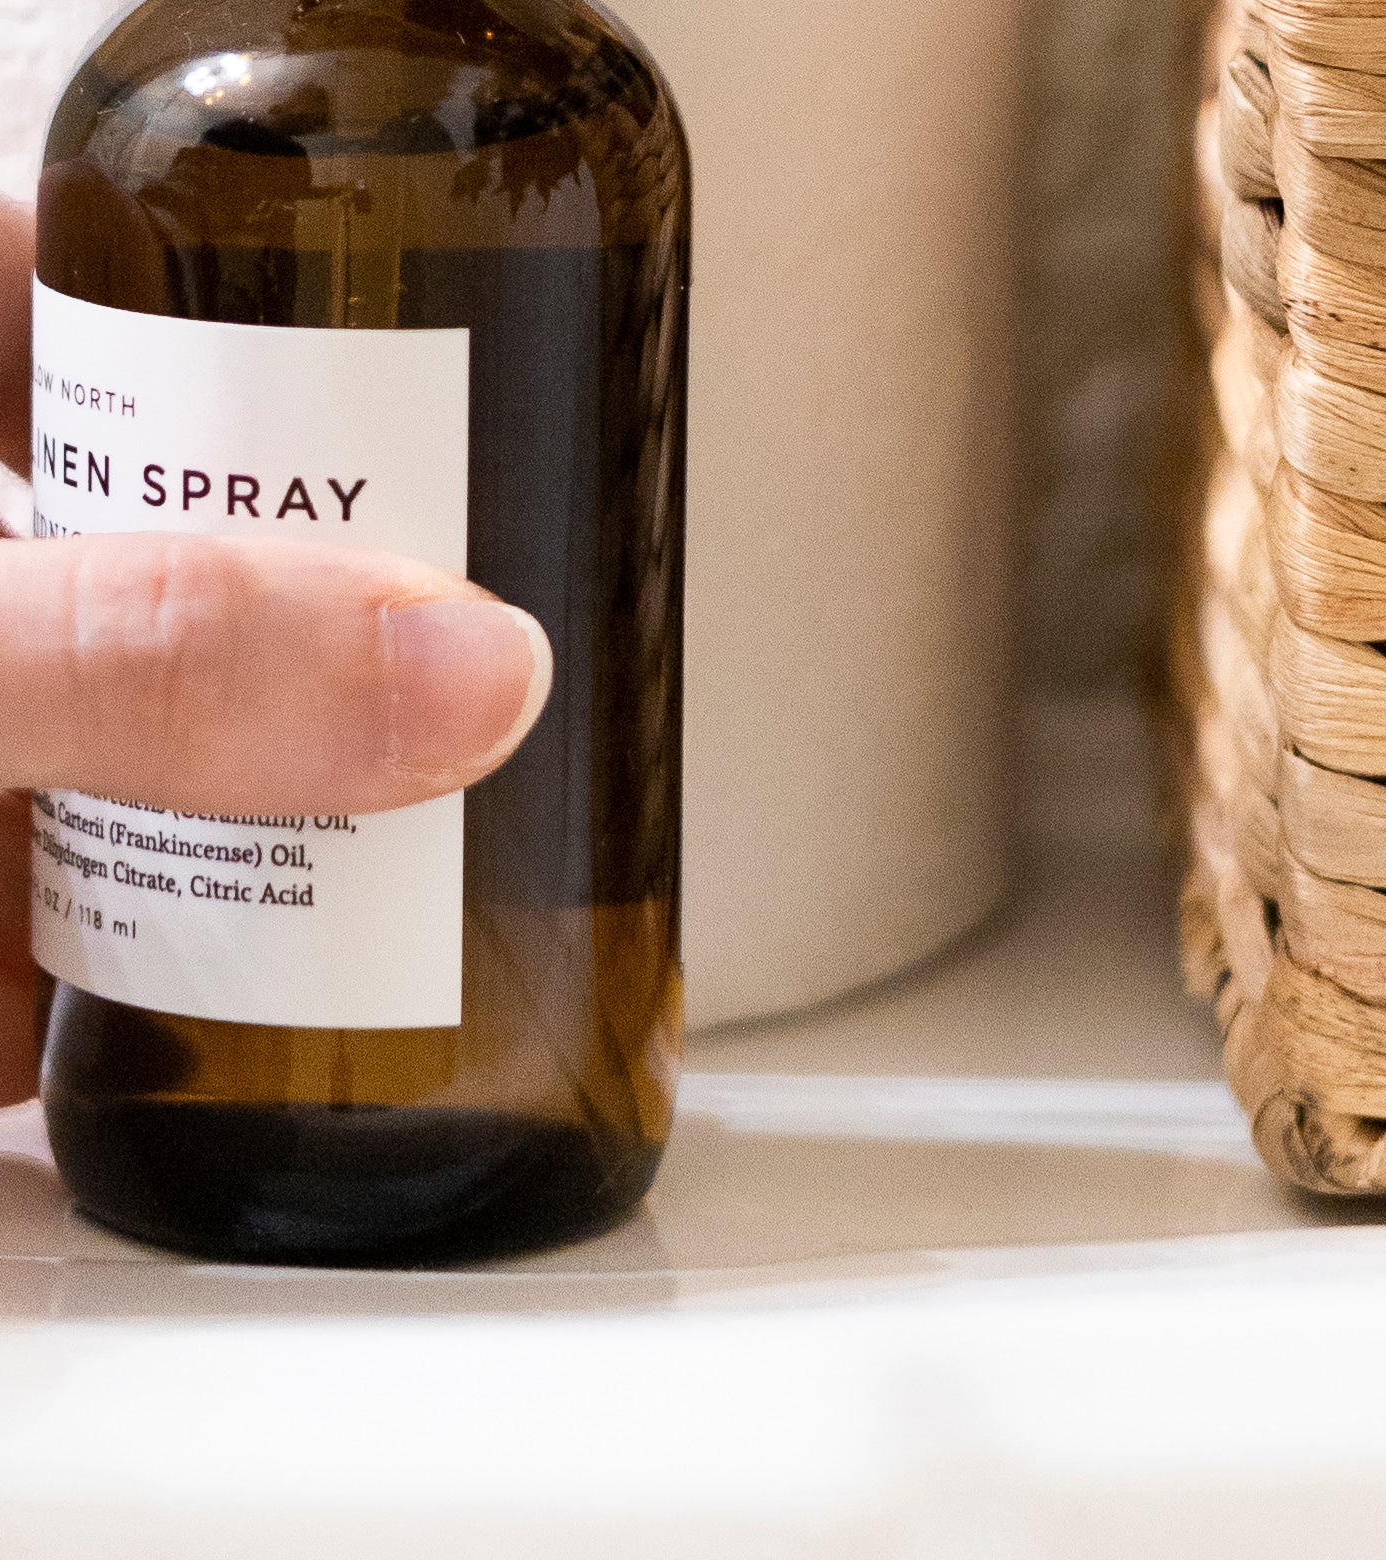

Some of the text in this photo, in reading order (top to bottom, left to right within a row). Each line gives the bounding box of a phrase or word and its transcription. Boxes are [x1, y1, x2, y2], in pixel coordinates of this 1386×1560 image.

[35, 364, 135, 417] OW NORTH
[35, 427, 110, 498] INEN
[142, 463, 368, 522] SPRAY
[57, 801, 105, 840] Carterii
[109, 820, 263, 869] (Frankincense)
[270, 843, 314, 871] Oil,
[113, 860, 183, 898] Citrate,
[190, 875, 253, 903] Citric
[258, 881, 315, 906] Acid
[78, 903, 103, 931] 118
[113, 918, 137, 940] ml
